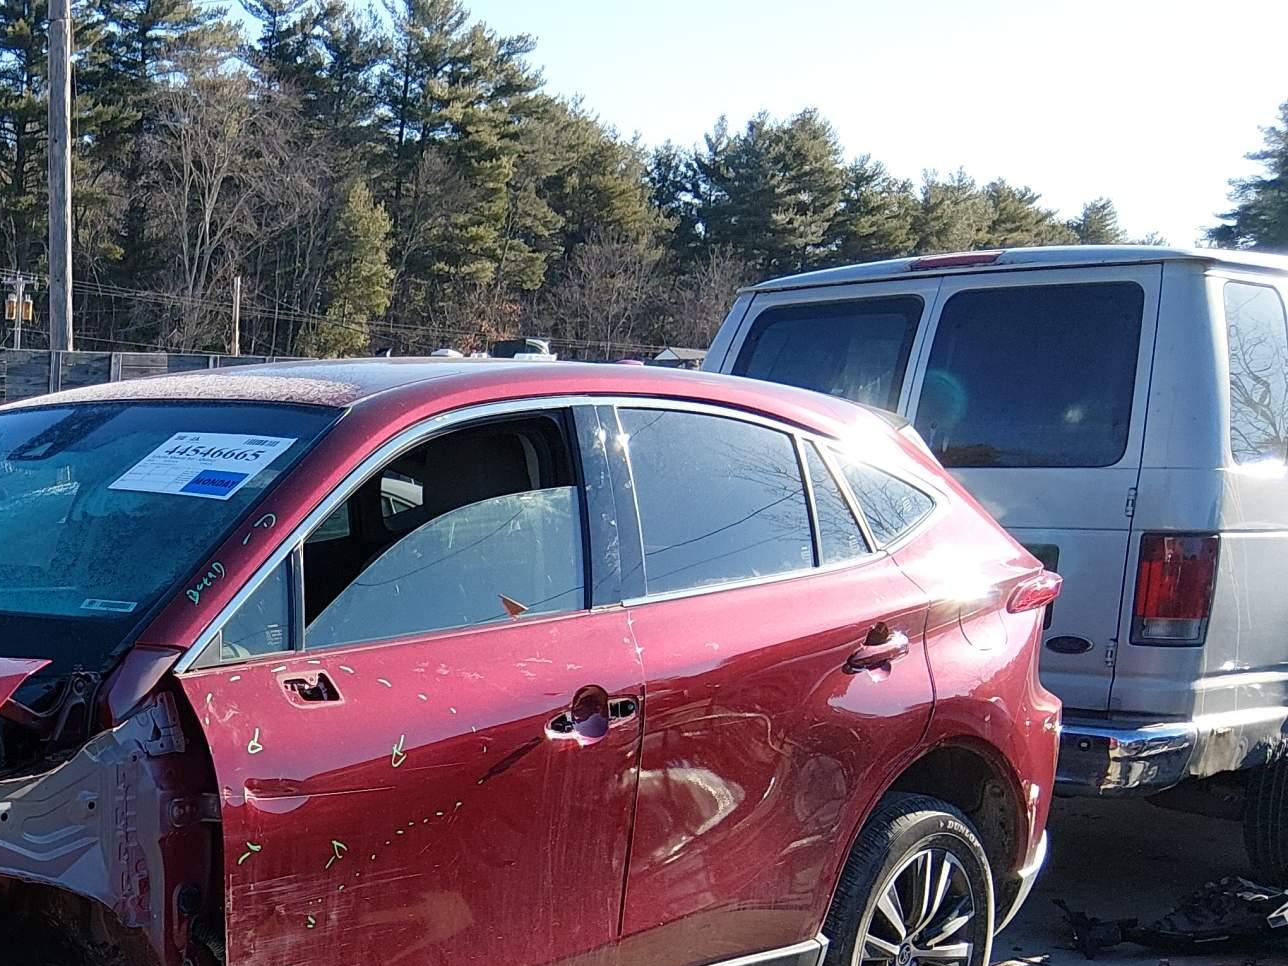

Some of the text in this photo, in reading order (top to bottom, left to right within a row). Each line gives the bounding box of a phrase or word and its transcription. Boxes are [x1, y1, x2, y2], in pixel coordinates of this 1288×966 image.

[165, 445, 264, 461] 44546665
[194, 477, 241, 489] MONDAY
[946, 820, 981, 848] DUNLOP
